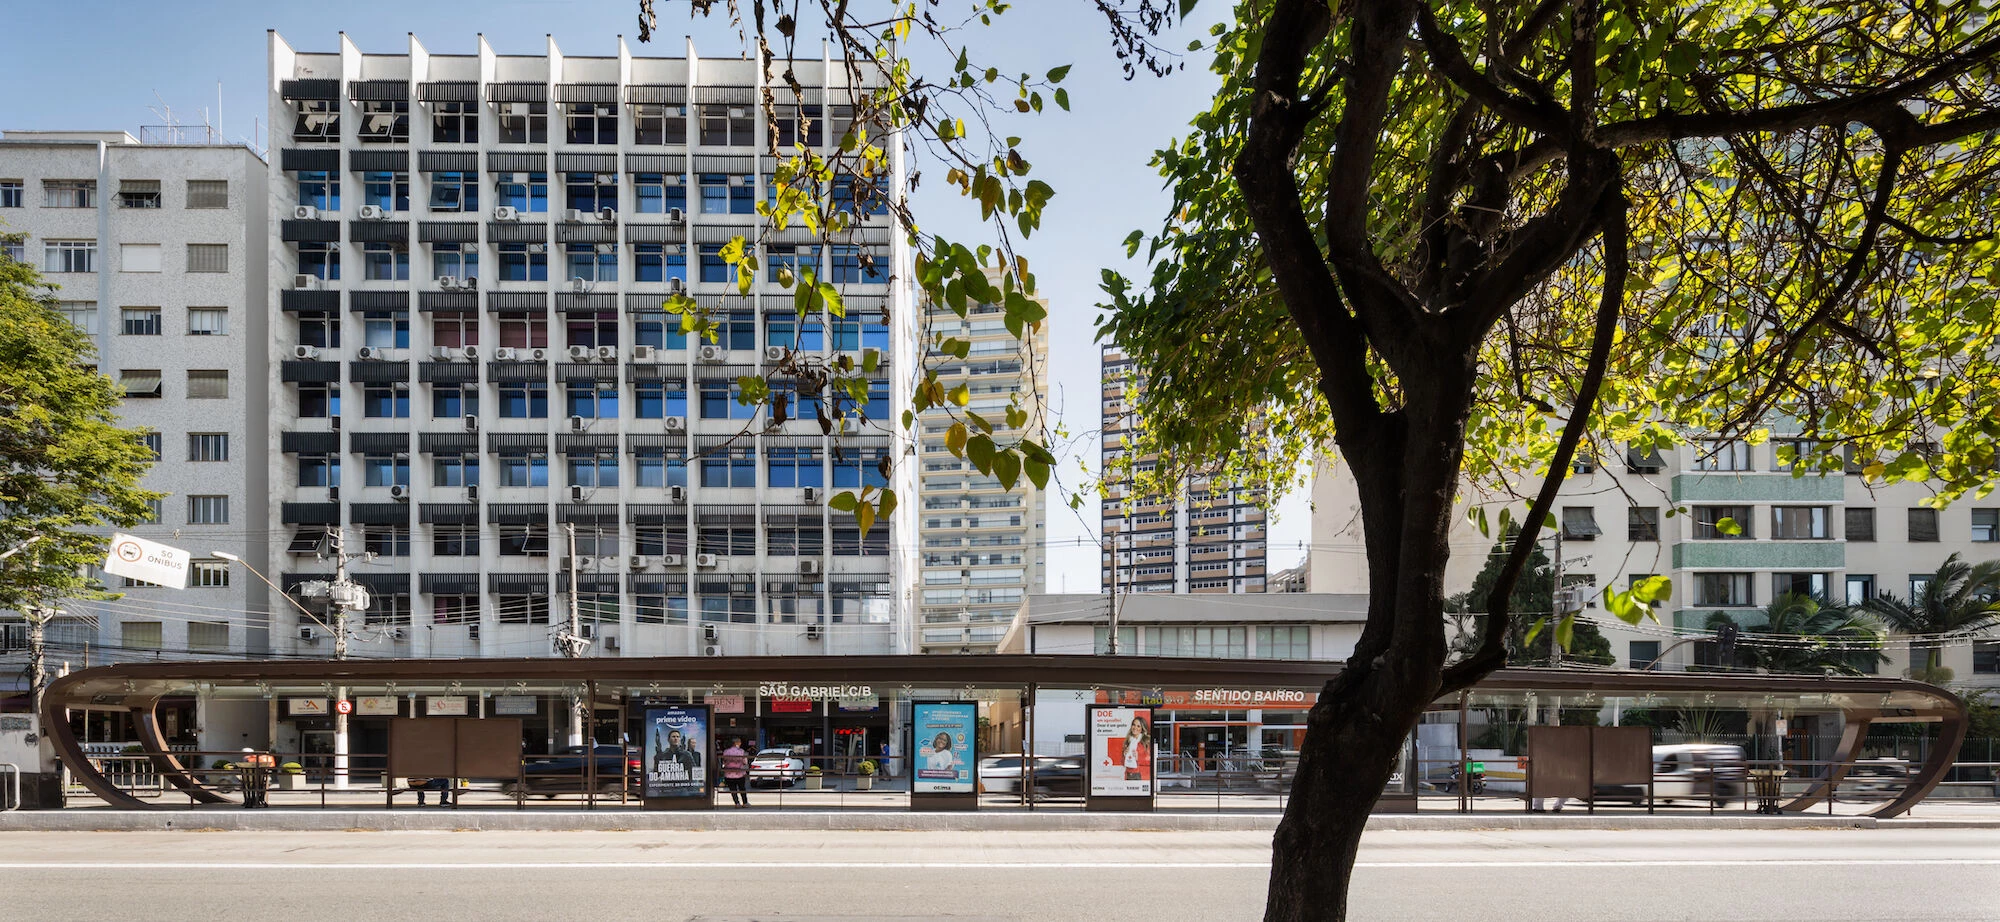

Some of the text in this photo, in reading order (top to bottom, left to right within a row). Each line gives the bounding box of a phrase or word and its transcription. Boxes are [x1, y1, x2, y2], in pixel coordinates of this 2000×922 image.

[760, 683, 787, 697] SÃO
[1195, 690, 1250, 701] SENTIDO
[1254, 690, 1304, 702] BAIRRO
[656, 716, 676, 724] prime
[672, 754, 677, 763] A
[657, 763, 684, 772] GUERRA
[649, 772, 658, 781] DO
